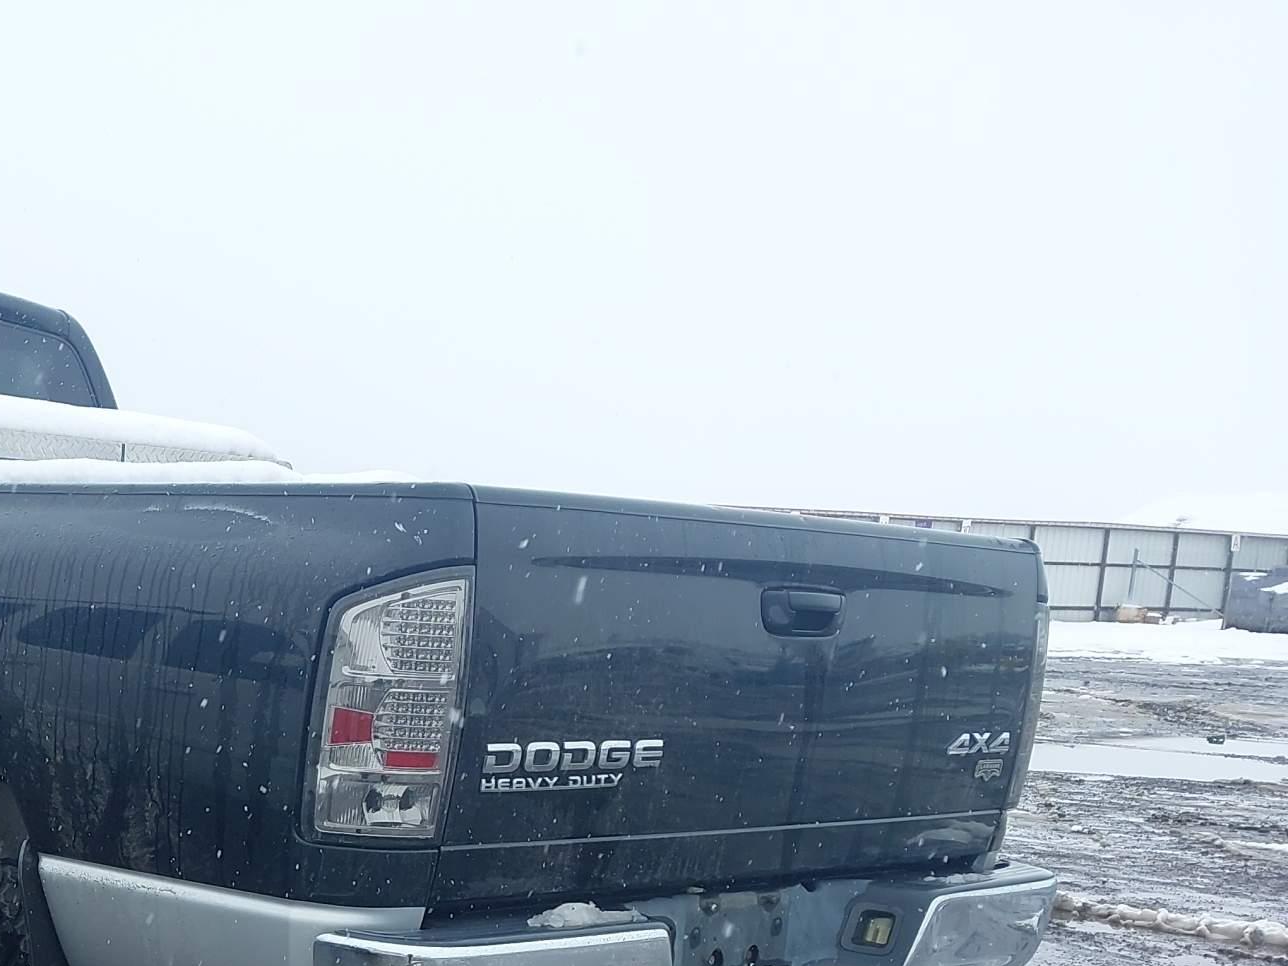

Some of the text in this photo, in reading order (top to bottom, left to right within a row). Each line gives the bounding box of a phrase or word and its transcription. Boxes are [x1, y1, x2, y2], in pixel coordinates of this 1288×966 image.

[947, 731, 1010, 756] 4X4
[482, 739, 664, 774] DODGE
[481, 772, 624, 792] HEAVY DUTY
